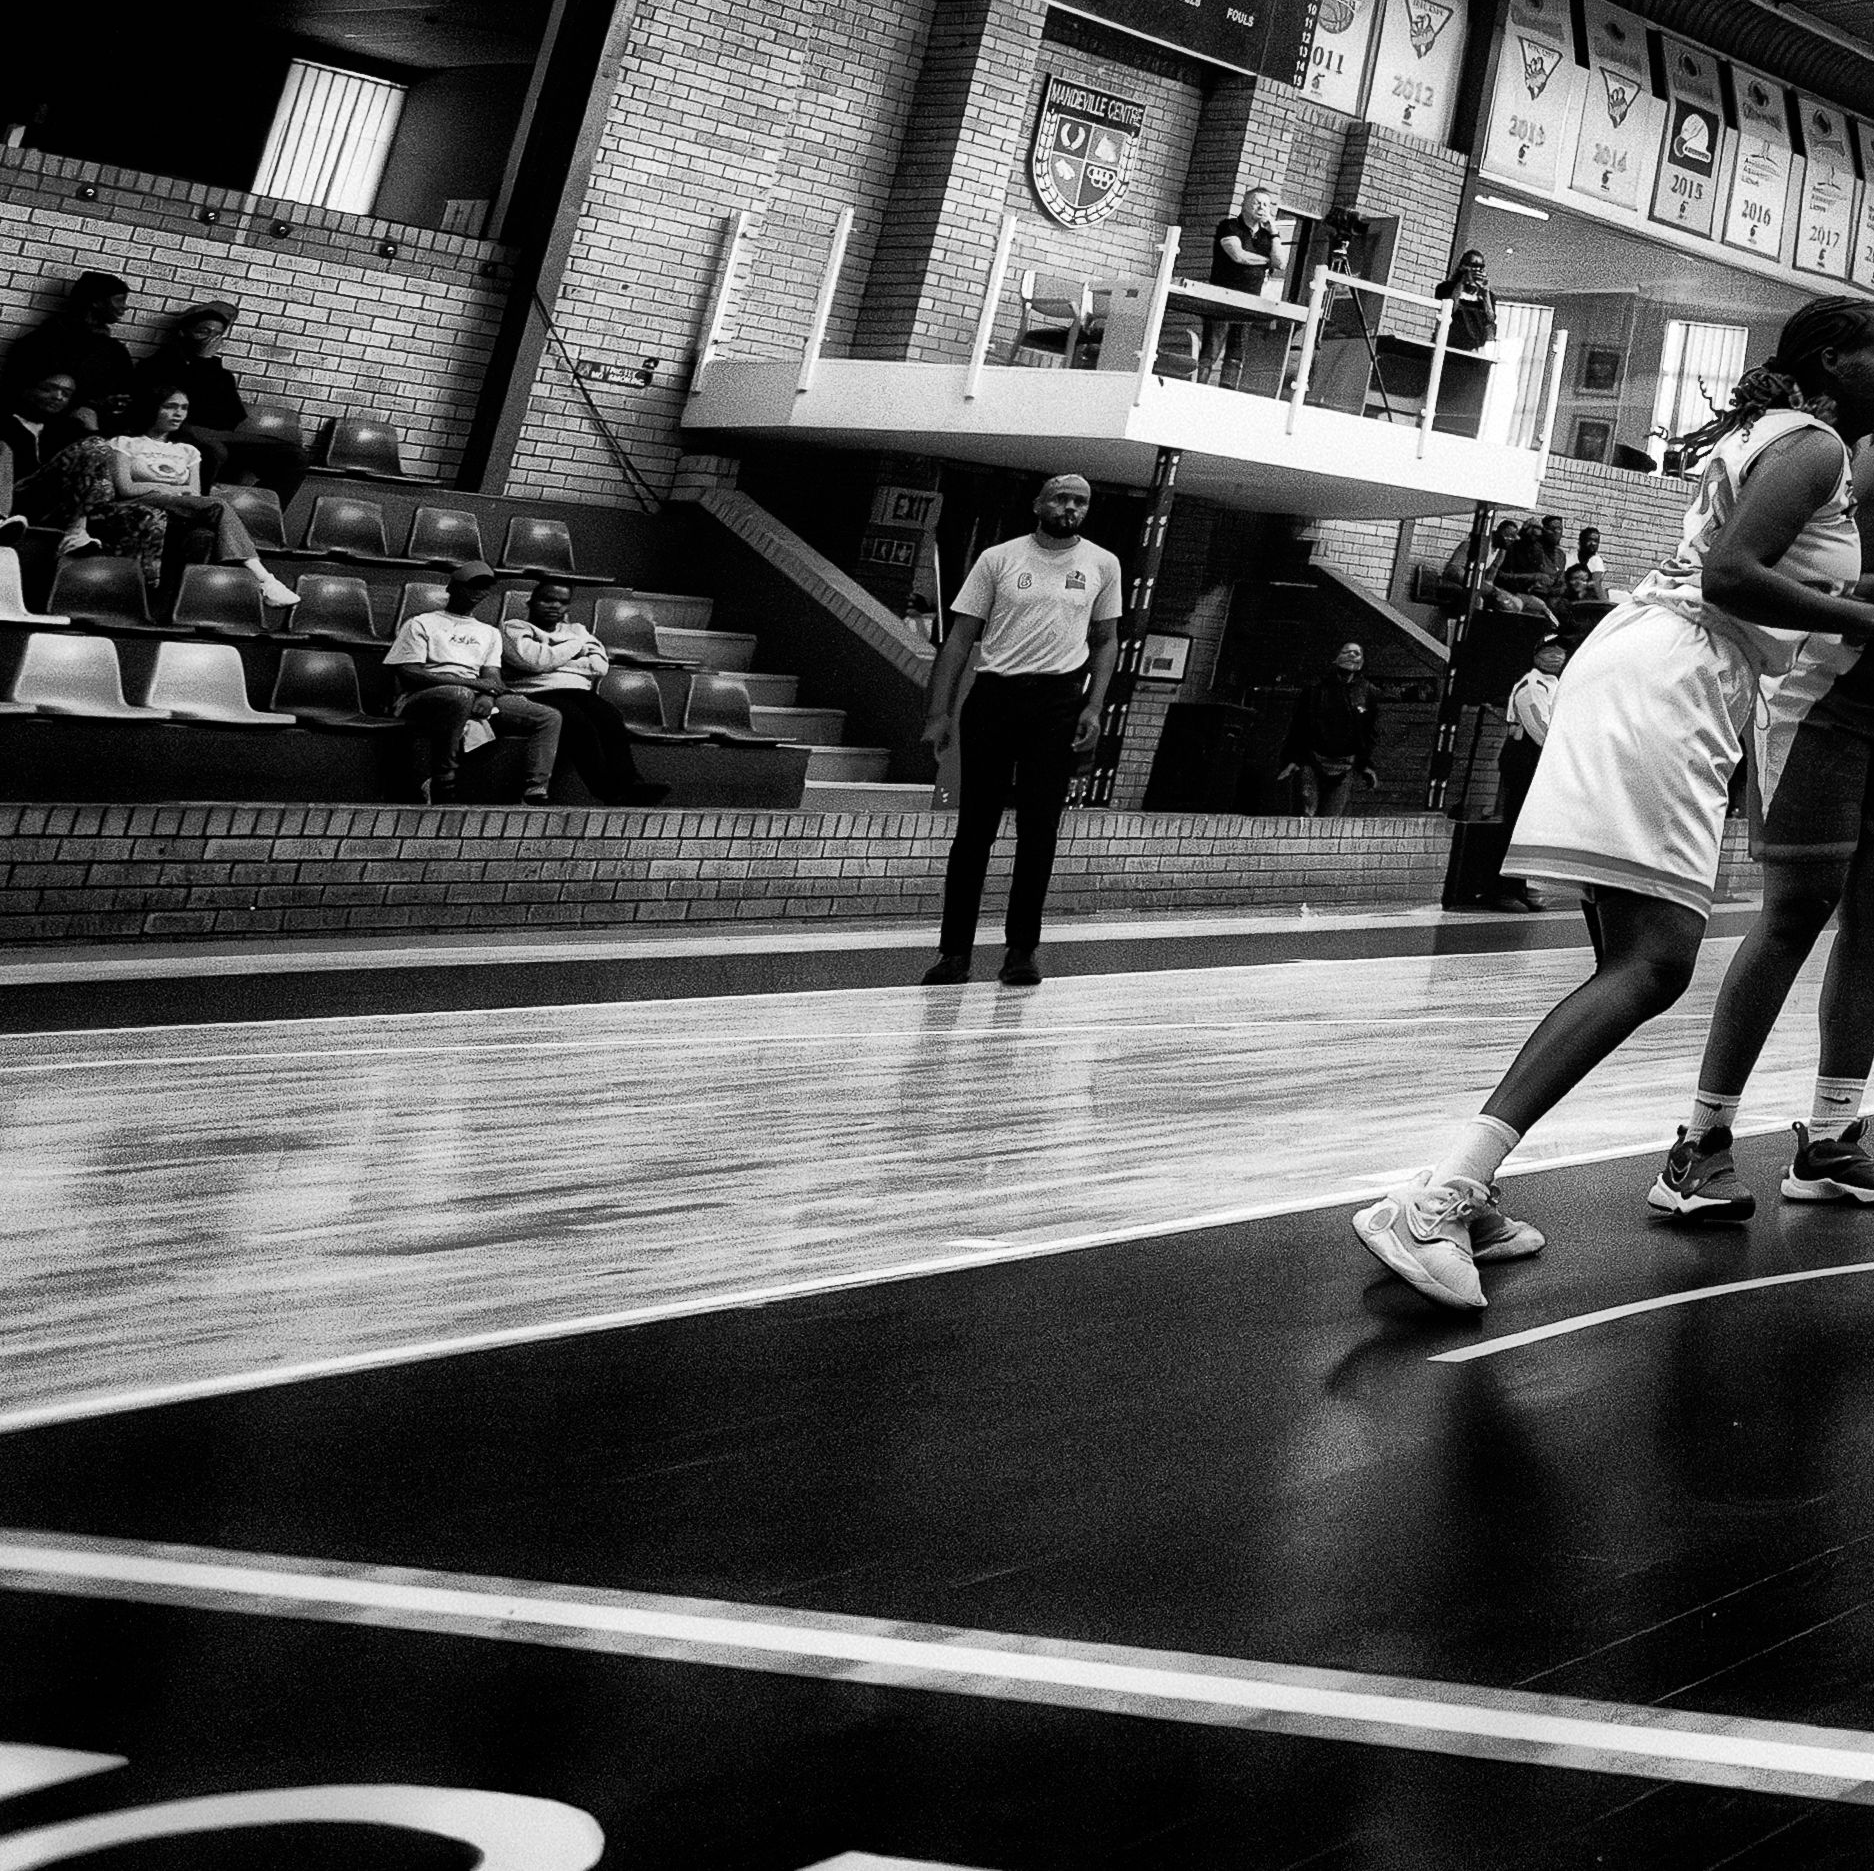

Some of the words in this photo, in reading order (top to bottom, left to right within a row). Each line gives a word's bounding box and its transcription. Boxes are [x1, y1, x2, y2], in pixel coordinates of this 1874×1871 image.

[1226, 7, 1255, 27] FOULS
[1307, 3, 1317, 15] 10
[1305, 17, 1313, 29] 11
[1302, 32, 1311, 44] 12
[1299, 45, 1308, 58] 13
[1312, 45, 1345, 75] 011
[1296, 59, 1305, 72] 14
[1392, 75, 1434, 107] 2012
[1050, 82, 1108, 118] MANDEVILLE
[1108, 100, 1144, 127] CENTRE
[1670, 174, 1704, 200] 2015
[1741, 199, 1771, 227] 2016
[1808, 226, 1840, 248] 2017
[892, 493, 937, 531] EXIT
